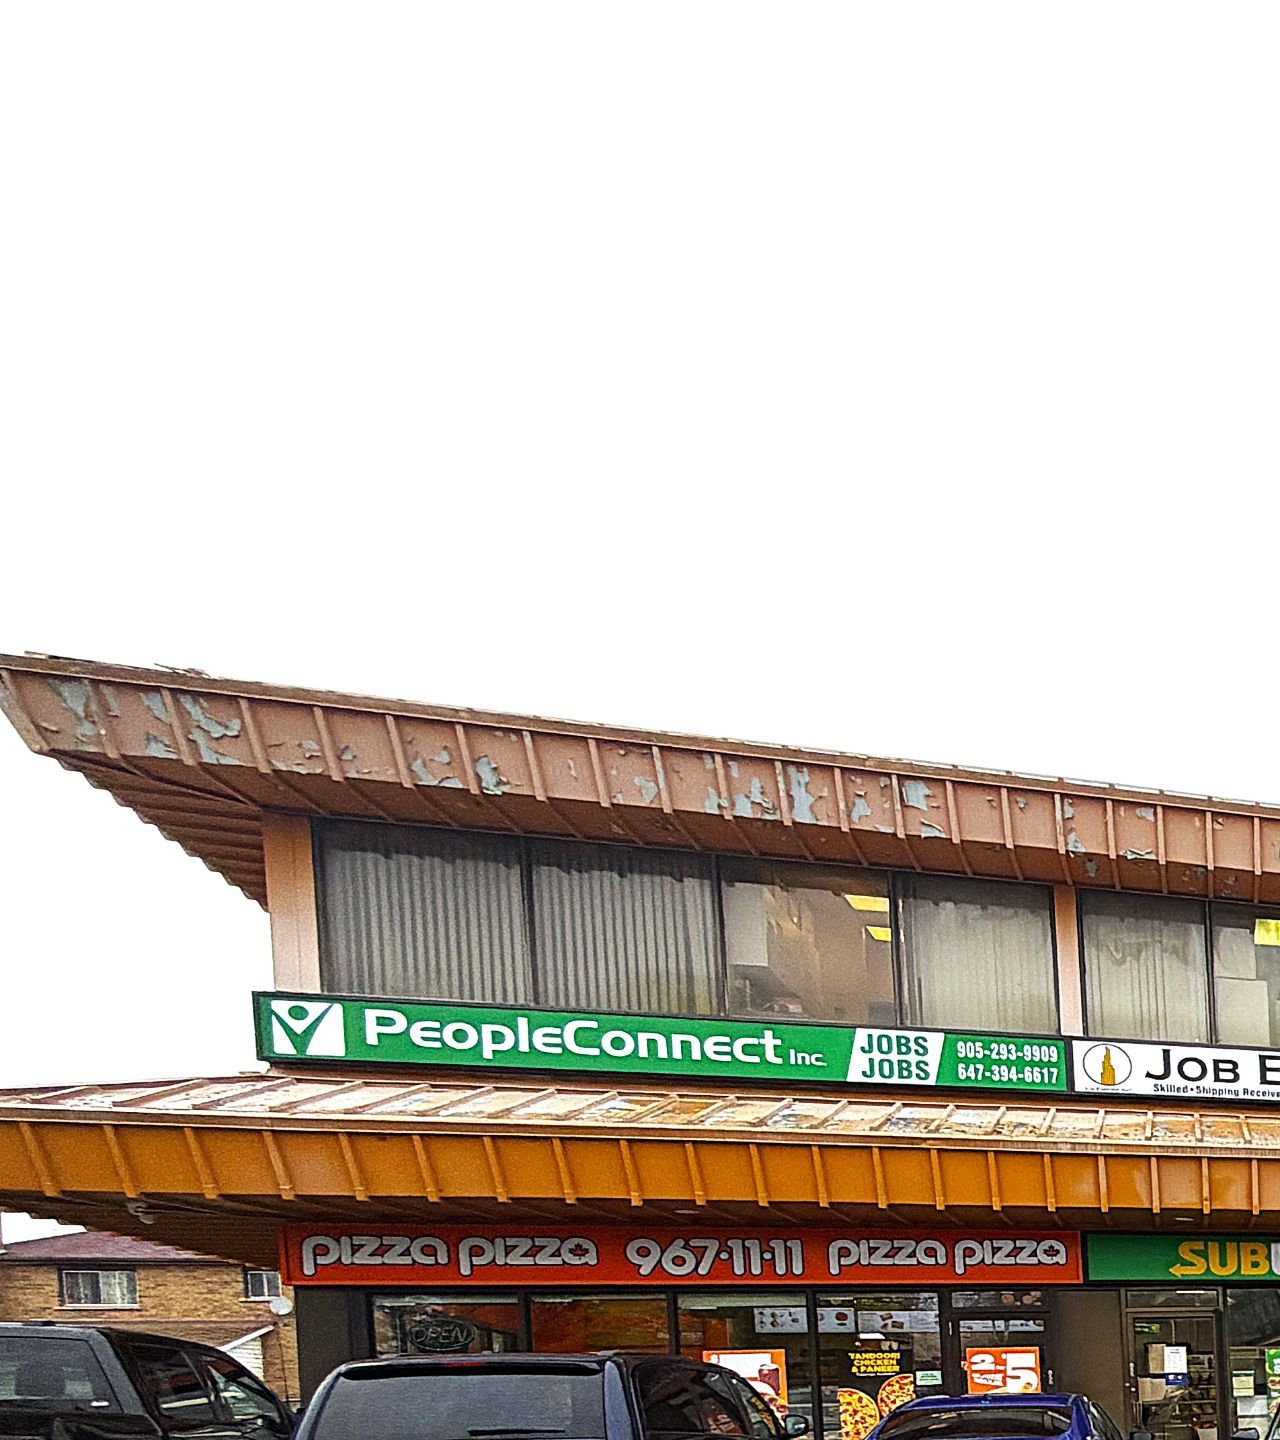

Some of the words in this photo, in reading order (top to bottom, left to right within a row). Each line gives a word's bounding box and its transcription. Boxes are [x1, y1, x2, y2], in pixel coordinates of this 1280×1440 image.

[365, 1008, 783, 1064] PeopleConnect
[789, 1048, 828, 1067] Inc
[860, 1033, 929, 1057] JOBS
[956, 1041, 1059, 1063] 905-293-9909
[862, 1057, 930, 1081] JOBS
[957, 1063, 1059, 1084] 647-394-6617
[1145, 1049, 1240, 1084] JOB
[303, 1236, 449, 1276] pizza
[459, 1236, 598, 1276] pizza
[829, 1239, 946, 1275] pizza
[954, 1239, 1067, 1275] pizza
[413, 1320, 468, 1343] OPEN
[848, 1352, 901, 1360] TANDOORI
[853, 1359, 897, 1367] CHICKEN
[860, 1365, 900, 1373] PANEER
